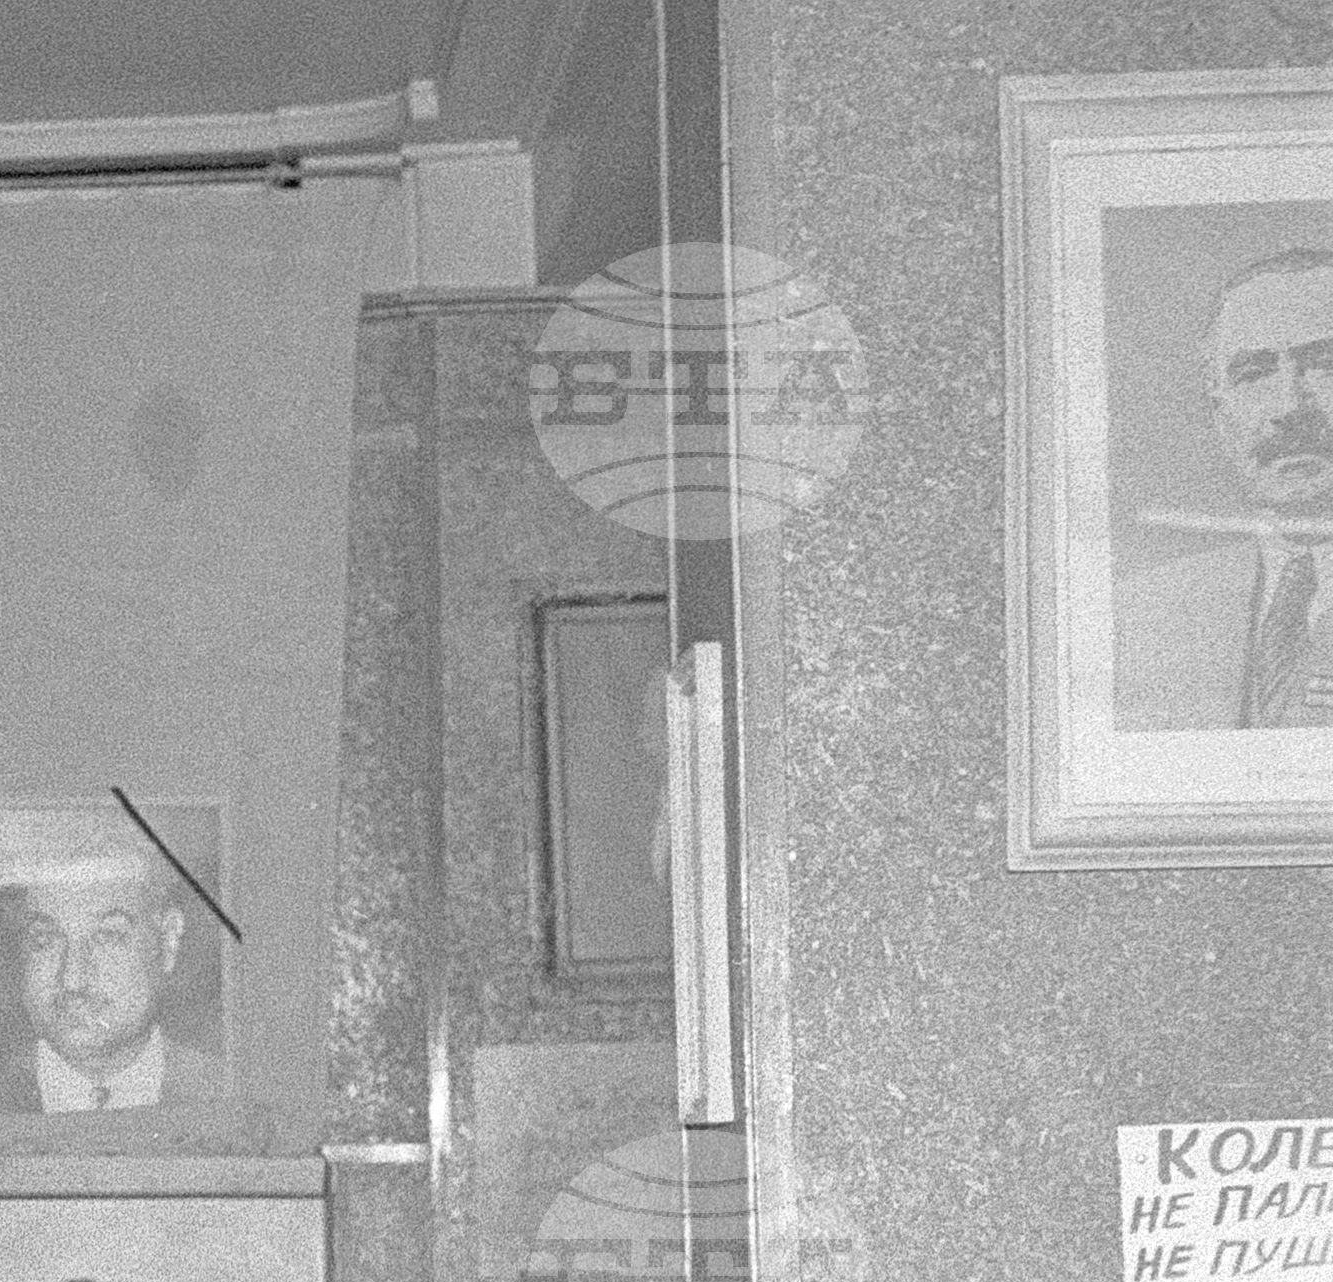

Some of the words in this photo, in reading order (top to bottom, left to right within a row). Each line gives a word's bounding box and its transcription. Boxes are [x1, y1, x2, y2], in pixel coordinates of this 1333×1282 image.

[1158, 1126, 1333, 1185] КОЛЕ
[1130, 1193, 1194, 1234] НЕ
[1213, 1181, 1333, 1226] ПАЛ
[1134, 1245, 1194, 1282] НЕ
